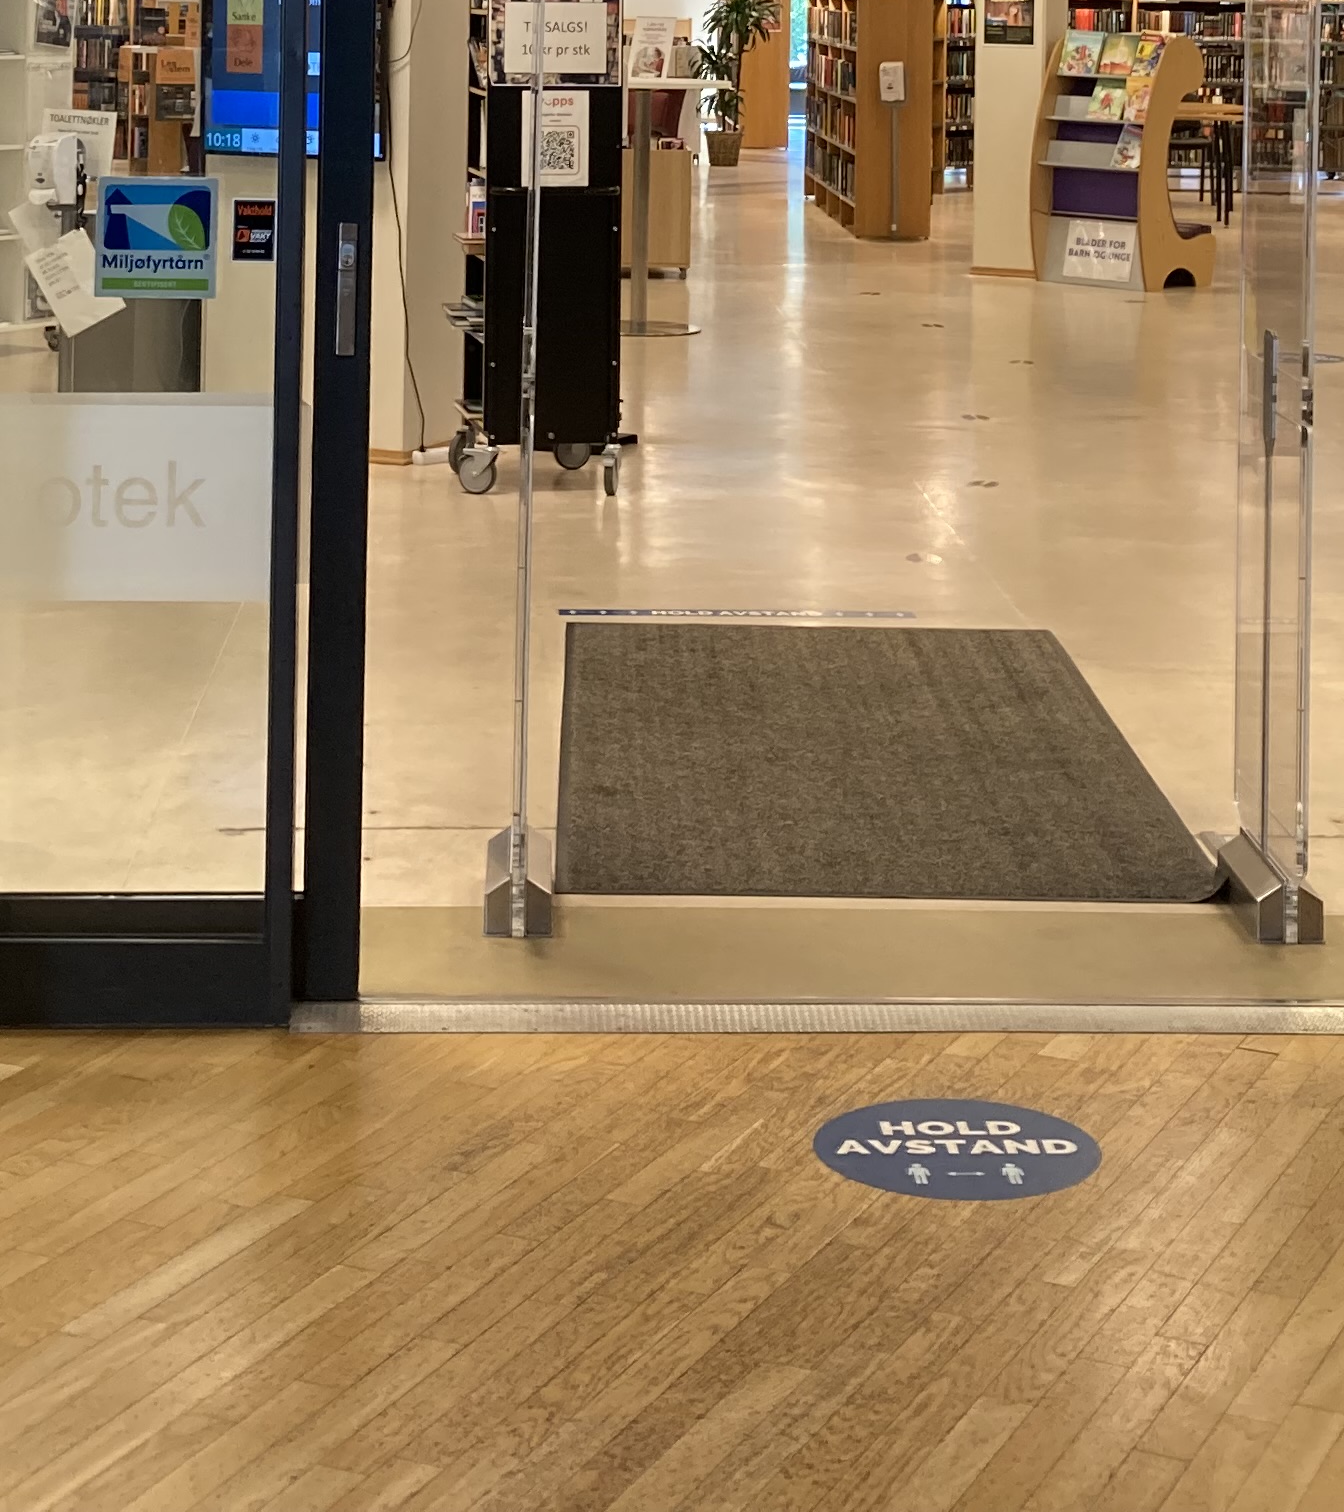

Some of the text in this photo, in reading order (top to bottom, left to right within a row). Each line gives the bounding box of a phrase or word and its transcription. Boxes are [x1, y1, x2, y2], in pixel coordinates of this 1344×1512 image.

[545, 22, 587, 32] SALGS!
[556, 47, 570, 57] pr
[573, 44, 590, 55] stk
[206, 133, 240, 147] 10:18
[879, 1120, 1021, 1136] HOLD
[837, 1139, 1078, 1155] AVSTAND
